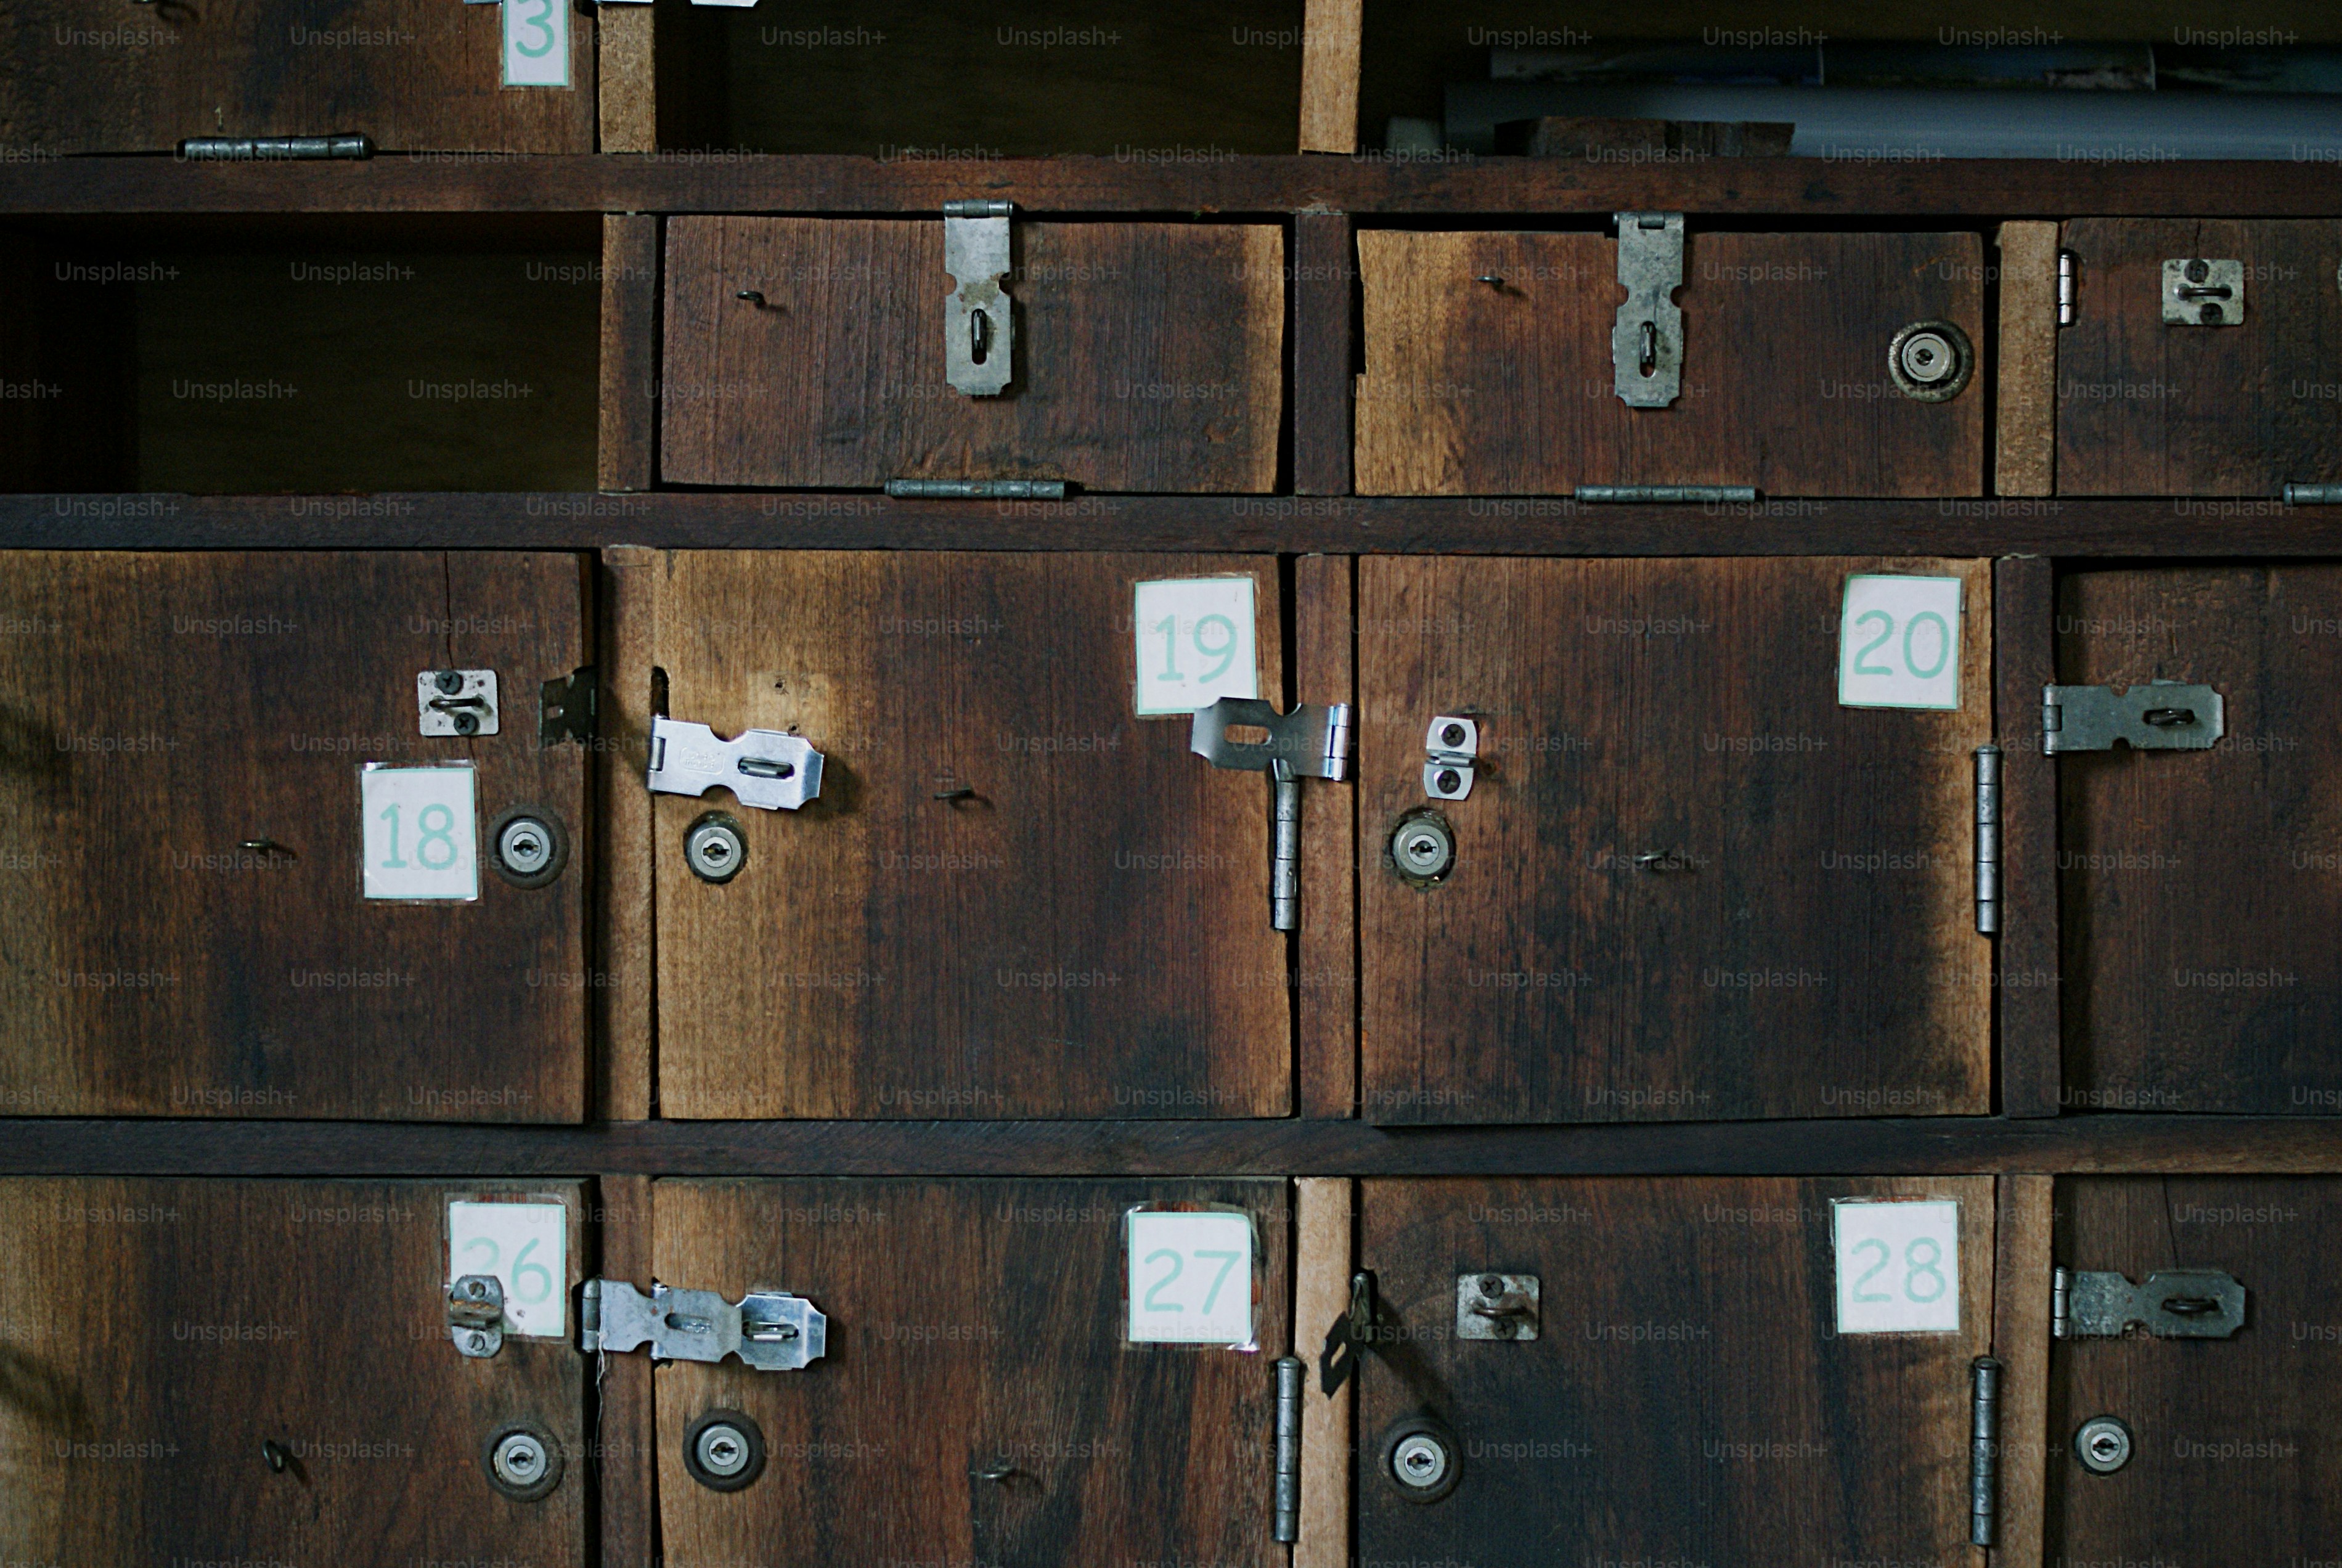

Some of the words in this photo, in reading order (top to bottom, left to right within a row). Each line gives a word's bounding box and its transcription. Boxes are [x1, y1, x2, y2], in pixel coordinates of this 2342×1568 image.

[516, 0, 554, 58] 3
[1155, 613, 1238, 684] 19
[1853, 610, 1949, 680] 20
[380, 802, 458, 870] 18
[1144, 1248, 1242, 1315] 27
[1851, 1236, 1946, 1304] 28
